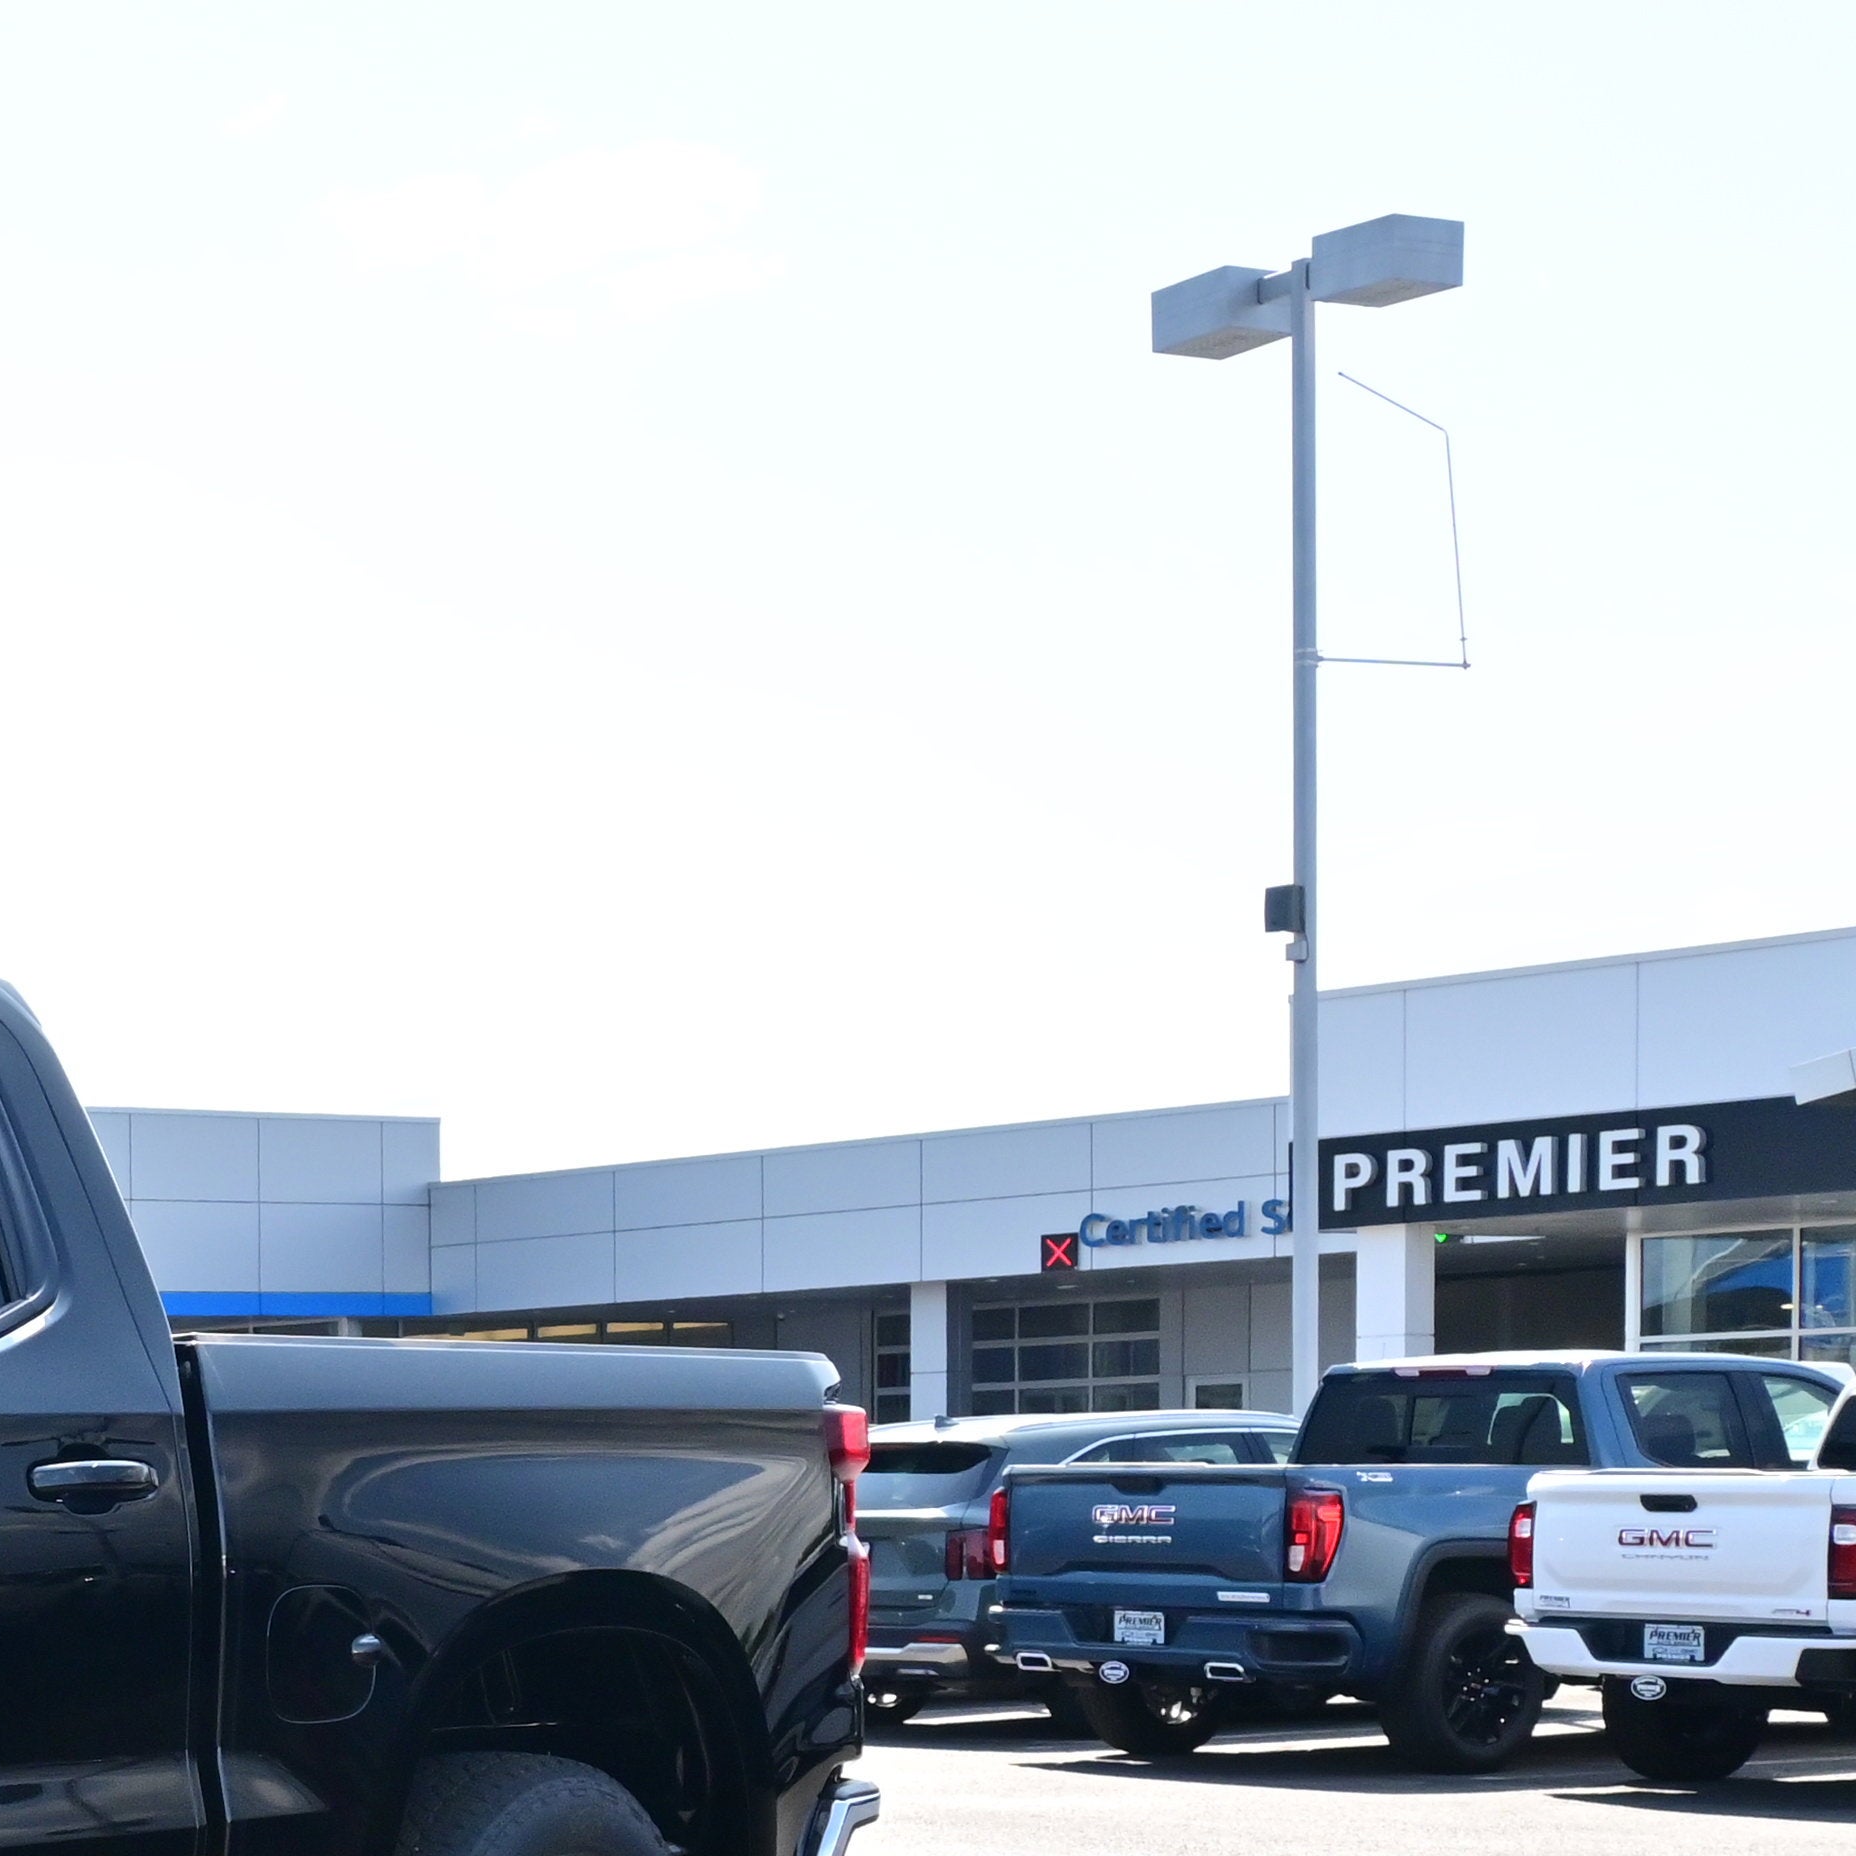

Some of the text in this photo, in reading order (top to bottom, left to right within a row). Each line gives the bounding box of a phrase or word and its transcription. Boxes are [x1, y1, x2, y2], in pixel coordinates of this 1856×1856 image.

[1333, 1124, 1707, 1212] PREMIER
[1079, 1200, 1246, 1248] Certified
[1092, 1504, 1176, 1525] GMC
[1092, 1534, 1172, 1544] SIERRA
[1618, 1528, 1717, 1549] GMC
[1649, 1628, 1701, 1644] PREMIER
